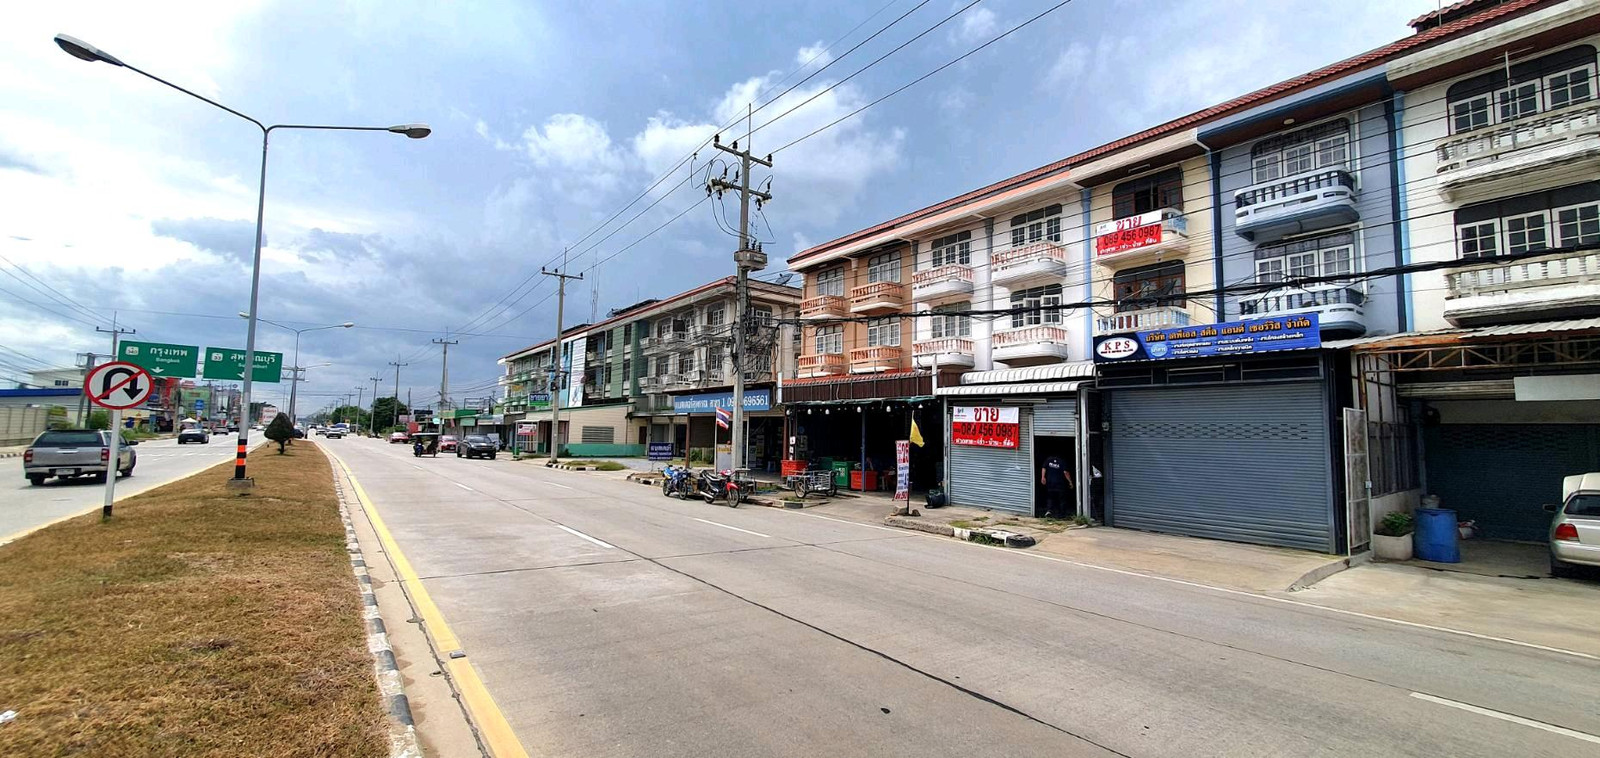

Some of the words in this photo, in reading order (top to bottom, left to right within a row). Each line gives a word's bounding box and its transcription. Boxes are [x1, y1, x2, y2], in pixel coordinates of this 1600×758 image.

[1116, 216, 1142, 230] ขาย
[1104, 234, 1118, 246] 089
[1121, 230, 1137, 241] 456
[1139, 224, 1161, 238] 0987
[1146, 331, 1165, 342] บริษัท
[1200, 326, 1217, 337] สตีล
[1221, 323, 1245, 335] แอนด์
[1249, 320, 1281, 332] เซอร์วิส
[1286, 317, 1310, 329] จำกัด
[150, 347, 187, 357] กรุงเทพ
[230, 353, 275, 364] สุพณบุรี
[974, 407, 999, 422] ขาย
[978, 424, 993, 437] 456
[995, 424, 1017, 438] 0987
